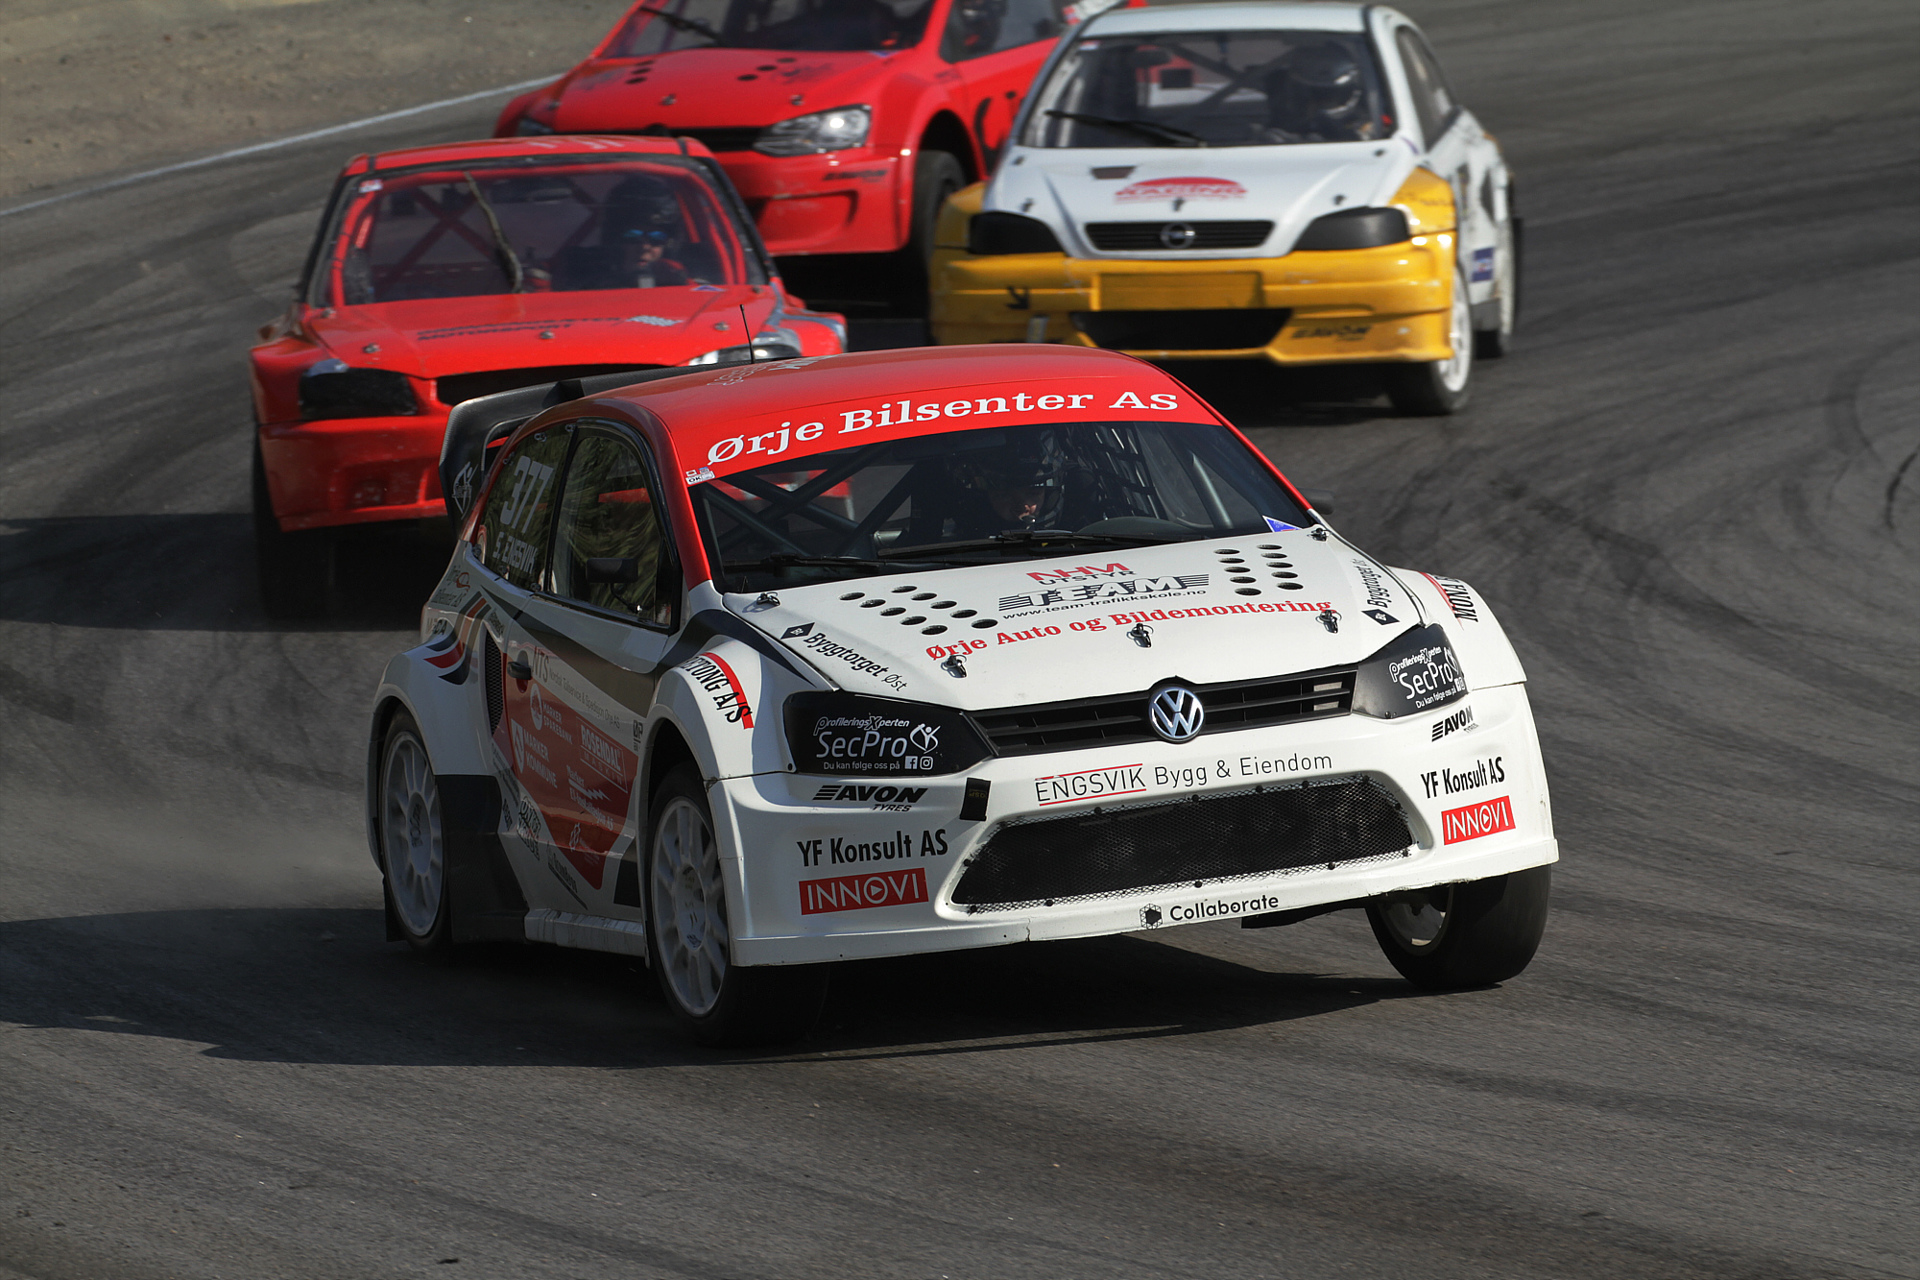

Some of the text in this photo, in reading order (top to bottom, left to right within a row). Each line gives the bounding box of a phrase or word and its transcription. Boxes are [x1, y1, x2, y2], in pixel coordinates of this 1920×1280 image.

[707, 391, 1178, 465] Ørje Bilsenter As
[500, 455, 554, 534] 377
[1026, 562, 1131, 581] NHM
[1038, 570, 1137, 586] UTSTYR
[1002, 590, 1206, 620] www.team-trafikkskole.no
[1018, 575, 1183, 607] TEAM
[1441, 583, 1479, 622] MONA
[926, 600, 1332, 661] Ørje Auto og Bildemontering
[803, 632, 908, 692] Byggtorget Øst
[1399, 662, 1454, 699] SecPro
[542, 701, 562, 725] MARKER
[712, 691, 753, 723] A/S
[1415, 700, 1425, 709] Du
[1424, 697, 1434, 706] kan
[813, 715, 910, 736] ProfileringsXperten
[1445, 705, 1473, 736] AVON
[523, 729, 549, 762] MARKER
[580, 724, 621, 771] ROSENDAL
[816, 731, 908, 758] SecPro
[526, 752, 558, 789] KOMMUNE
[852, 762, 873, 771] følge
[889, 762, 901, 771] på
[1035, 753, 1333, 802] ENGSVIK Bygg & Eiendom
[1420, 756, 1505, 799] YF Konsult AS
[834, 785, 928, 803] AVON
[872, 803, 912, 812] TYRES
[1446, 801, 1509, 841] INNOVI
[797, 828, 949, 867] YF Konsult AS
[807, 873, 920, 911] INNOVI
[1169, 894, 1279, 921] Collaborate
